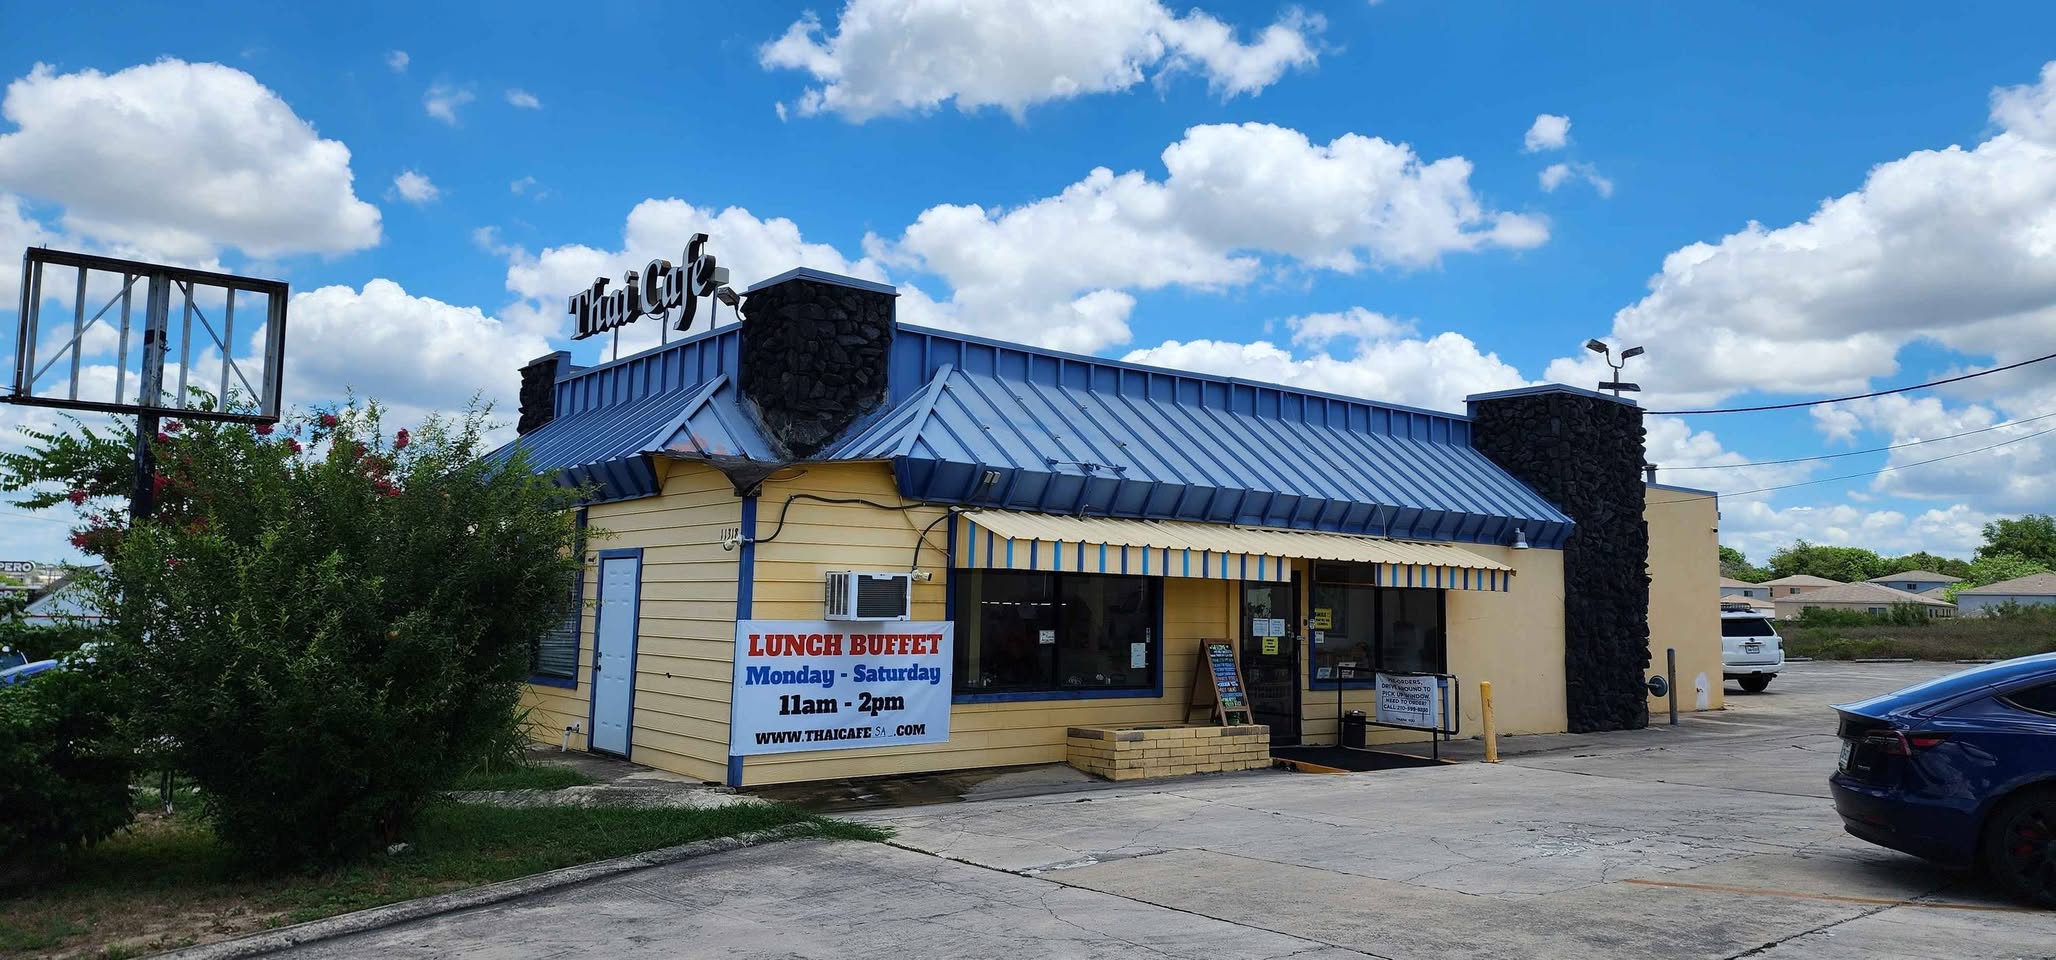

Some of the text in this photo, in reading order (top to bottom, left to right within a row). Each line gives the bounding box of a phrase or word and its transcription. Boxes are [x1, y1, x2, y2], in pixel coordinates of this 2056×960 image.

[569, 233, 716, 339] Thai Cafe
[748, 633, 943, 657] LUNCH BUFFET
[745, 665, 835, 688] Monday
[853, 663, 941, 685] Saturday
[779, 694, 838, 715] 11am
[858, 692, 905, 716] 2pm
